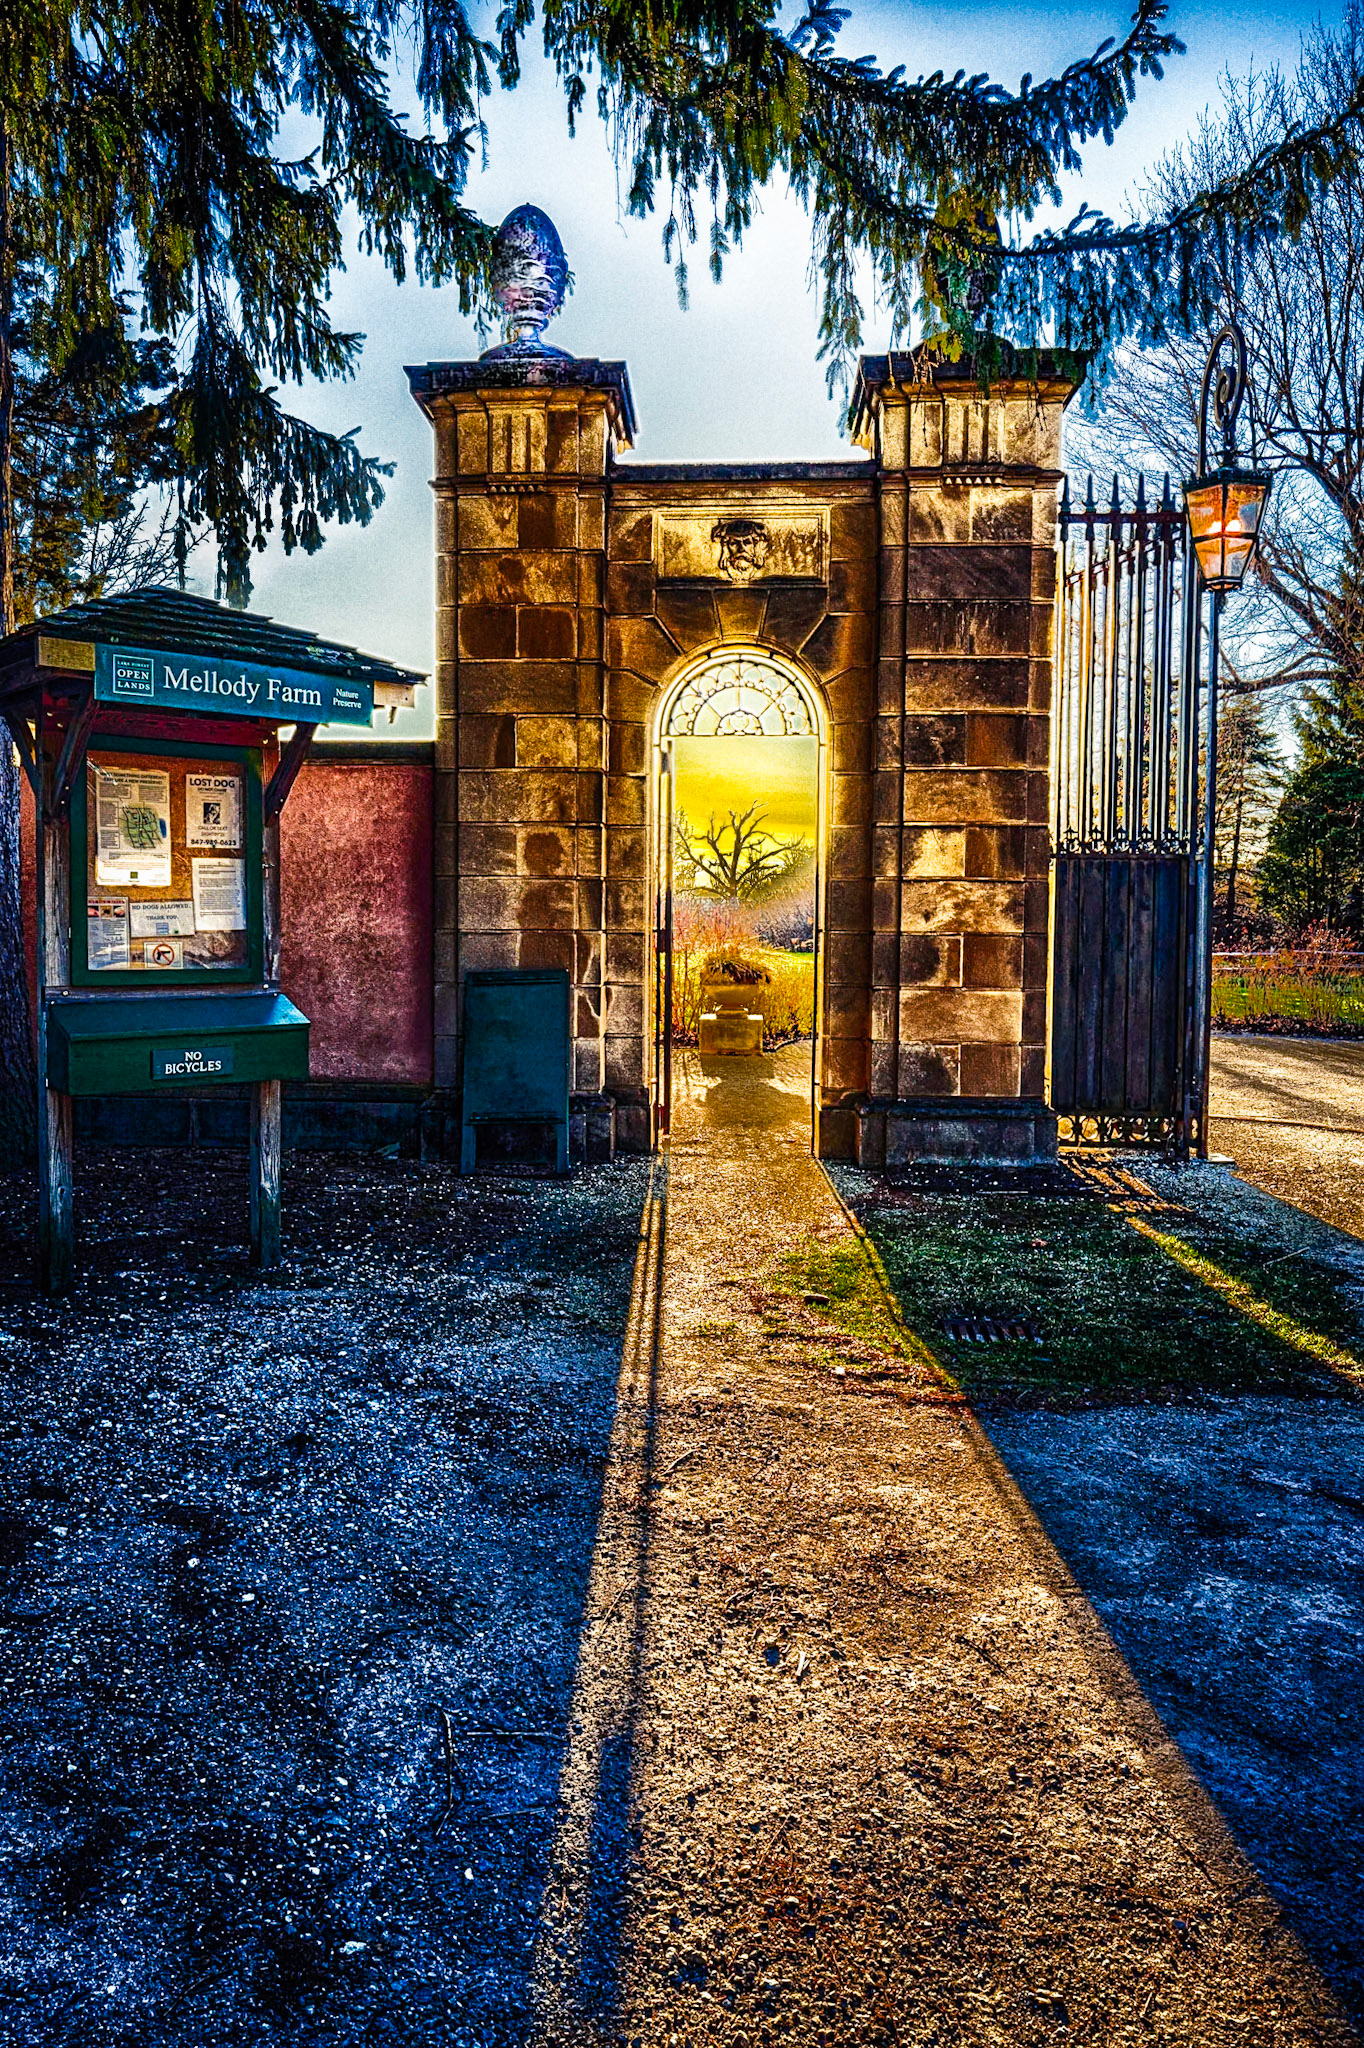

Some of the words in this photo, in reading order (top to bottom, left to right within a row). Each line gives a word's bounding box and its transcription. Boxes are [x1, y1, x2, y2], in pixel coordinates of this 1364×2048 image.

[117, 669, 149, 680] OPEN
[117, 681, 150, 691] LANDS
[163, 665, 260, 704] Mellody
[267, 678, 322, 706] Farm
[335, 688, 359, 699] Nature
[333, 697, 361, 708] Preserve
[189, 778, 212, 786] LOST
[214, 780, 235, 788] DOG
[184, 1051, 202, 1061] NO
[165, 1060, 221, 1075] BICYCLES
